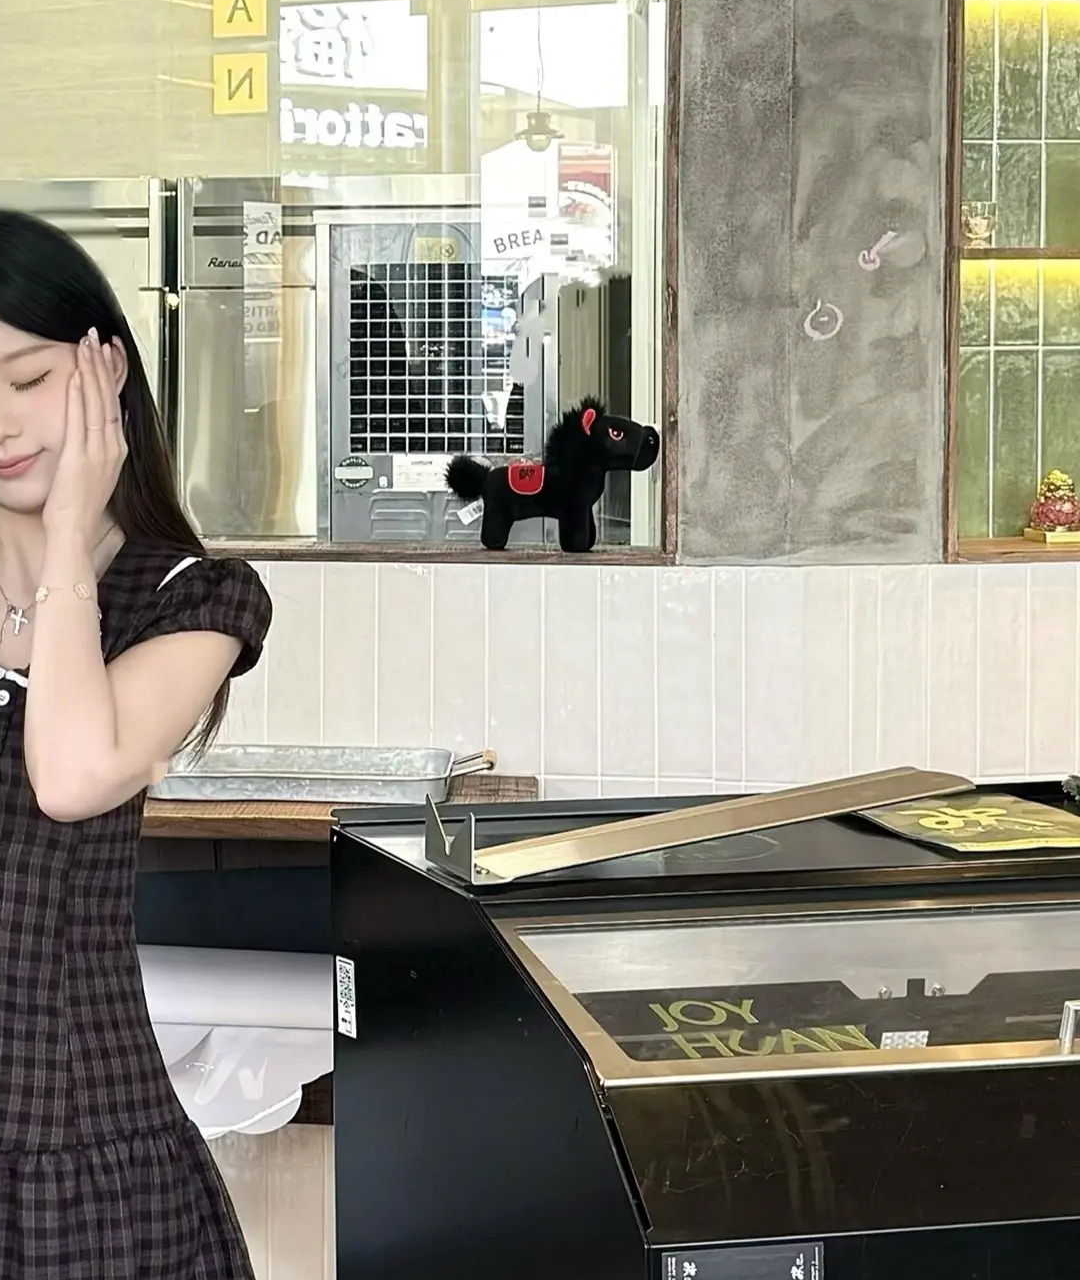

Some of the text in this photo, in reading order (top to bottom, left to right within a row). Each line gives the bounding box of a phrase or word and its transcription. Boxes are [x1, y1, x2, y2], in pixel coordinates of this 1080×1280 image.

[493, 229, 543, 254] BREA
[649, 999, 759, 1032] JOY
[670, 1024, 876, 1060] HUAN
